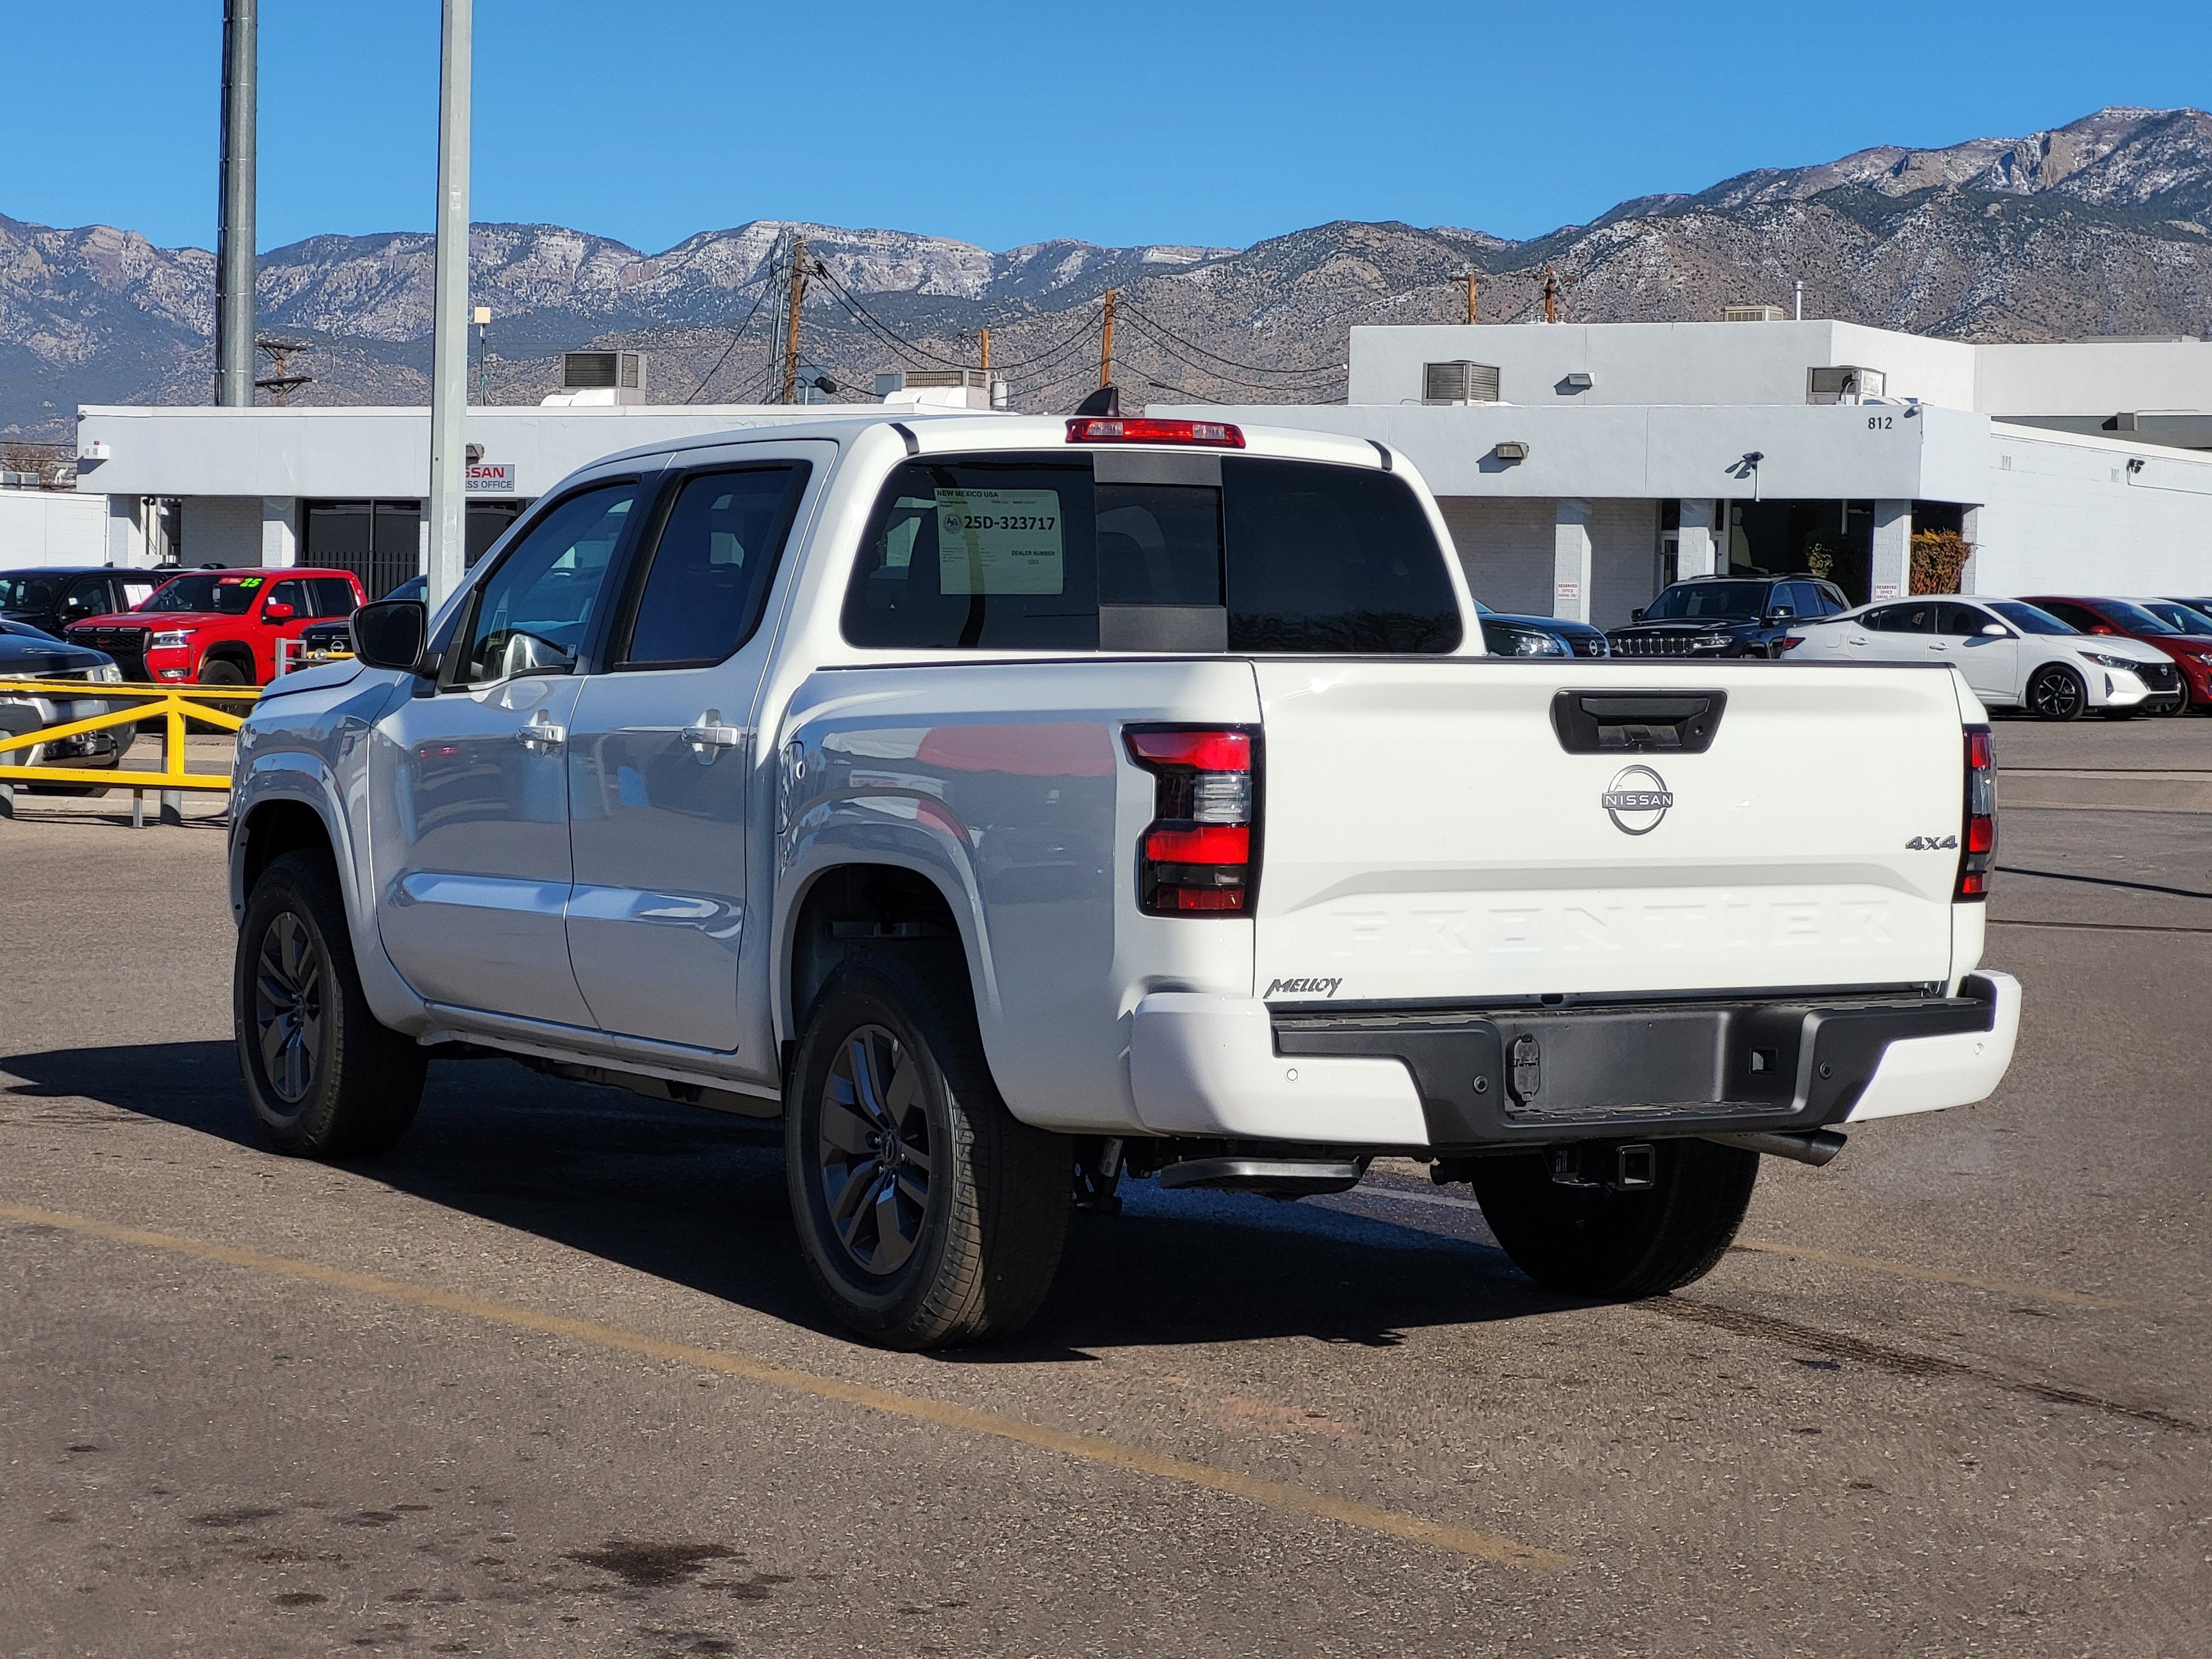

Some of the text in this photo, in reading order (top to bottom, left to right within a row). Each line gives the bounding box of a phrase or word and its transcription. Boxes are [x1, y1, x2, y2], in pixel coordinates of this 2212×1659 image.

[1868, 416, 1892, 430] 812
[964, 515, 1055, 530] 25D-323717
[240, 578, 263, 587] 25
[1605, 795, 1671, 805] NISSAN
[1327, 900, 1895, 958] FRONTIER
[1262, 978, 1343, 999] MELLOY
